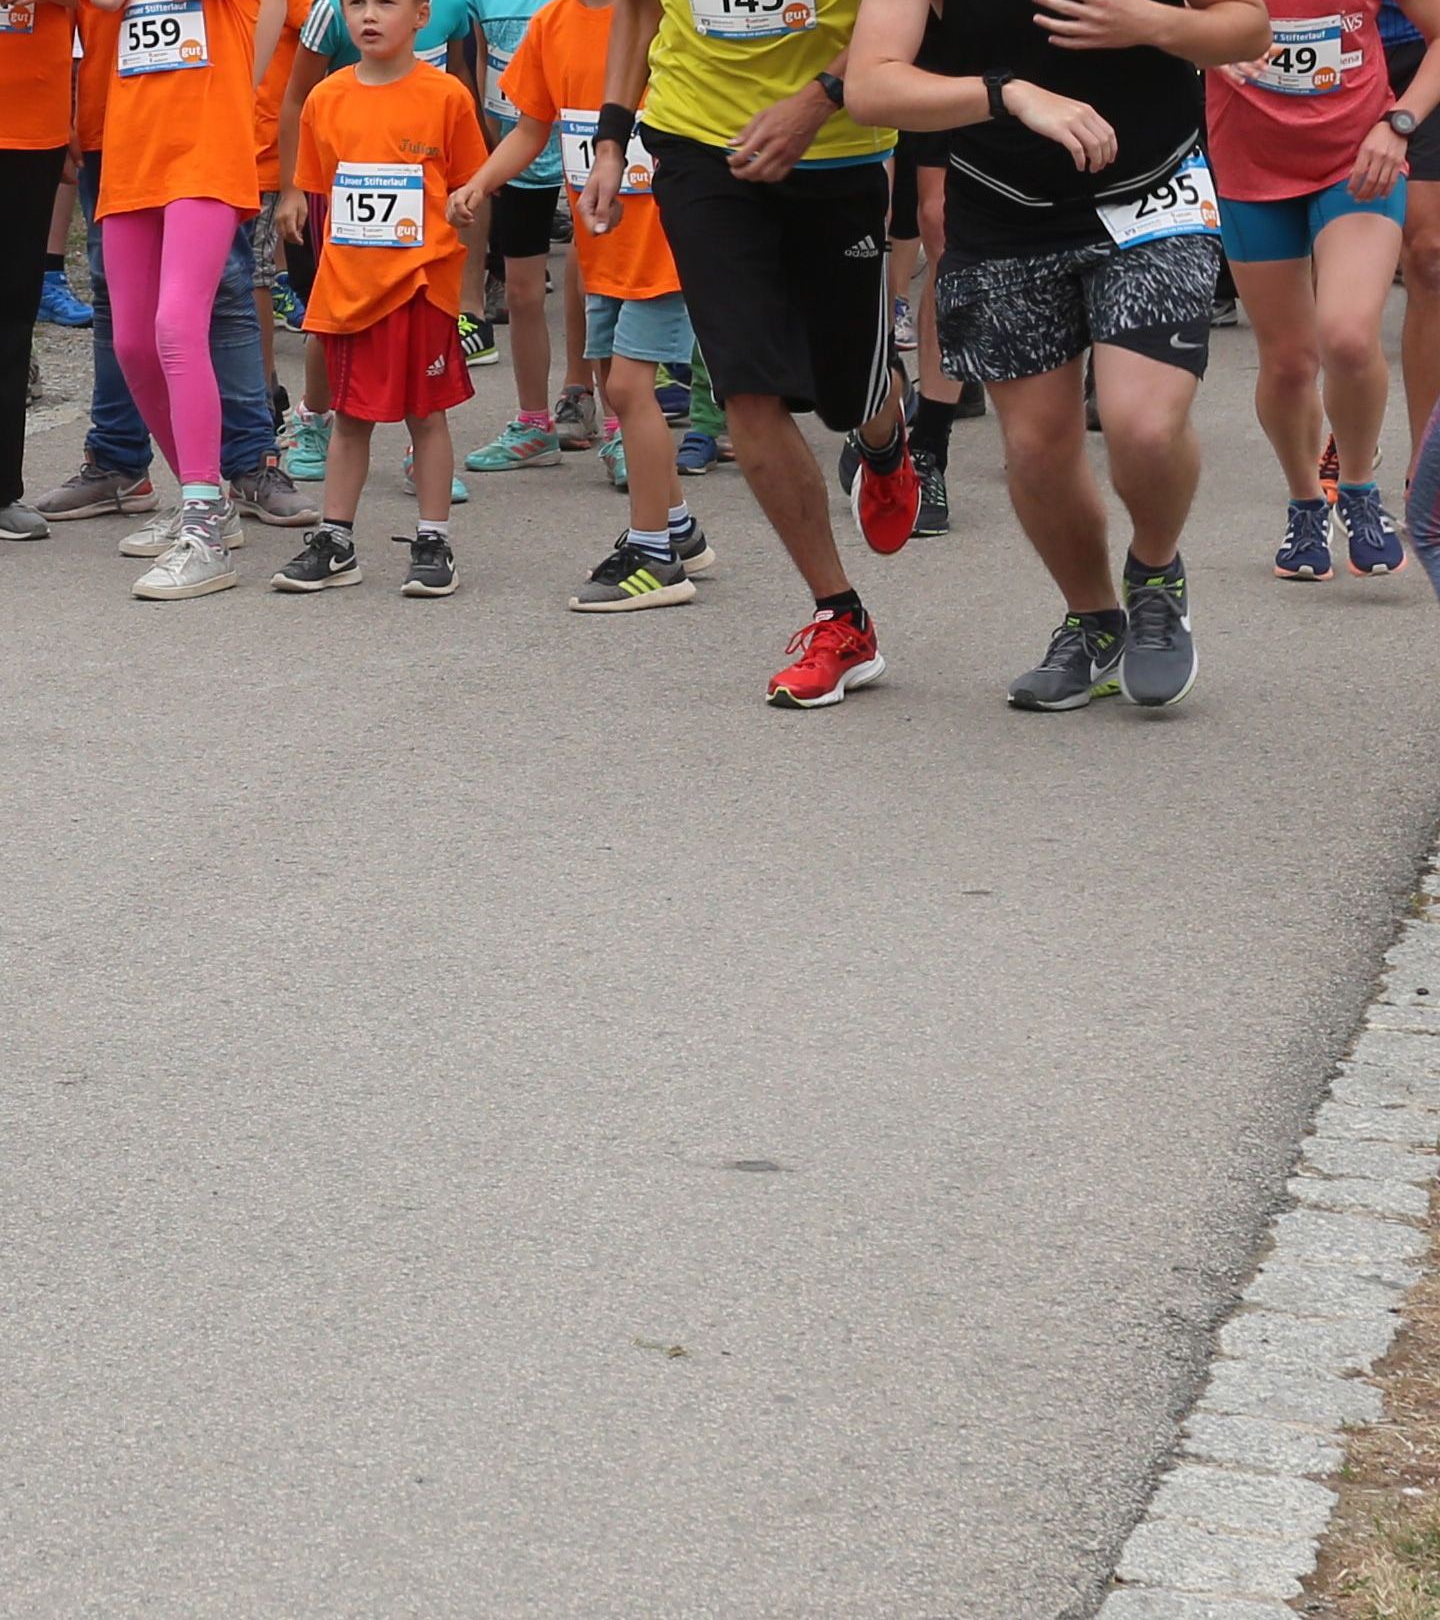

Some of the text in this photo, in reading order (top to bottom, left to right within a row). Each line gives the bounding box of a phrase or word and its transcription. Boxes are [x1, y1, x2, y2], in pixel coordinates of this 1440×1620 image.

[144, 2, 187, 14] Stifterlauf
[10, 12, 29, 23] gut
[784, 10, 807, 24] gut
[129, 18, 181, 51] 559
[1279, 31, 1326, 43] Stifterlauf
[181, 44, 202, 58] gut
[1341, 54, 1361, 65] ena
[1314, 72, 1336, 86] gut
[364, 177, 408, 187] Stifterlauf
[629, 170, 650, 184] gut
[1135, 174, 1199, 220] 295
[345, 193, 398, 222] 157
[396, 226, 416, 238] gut
[844, 248, 879, 258] adidas
